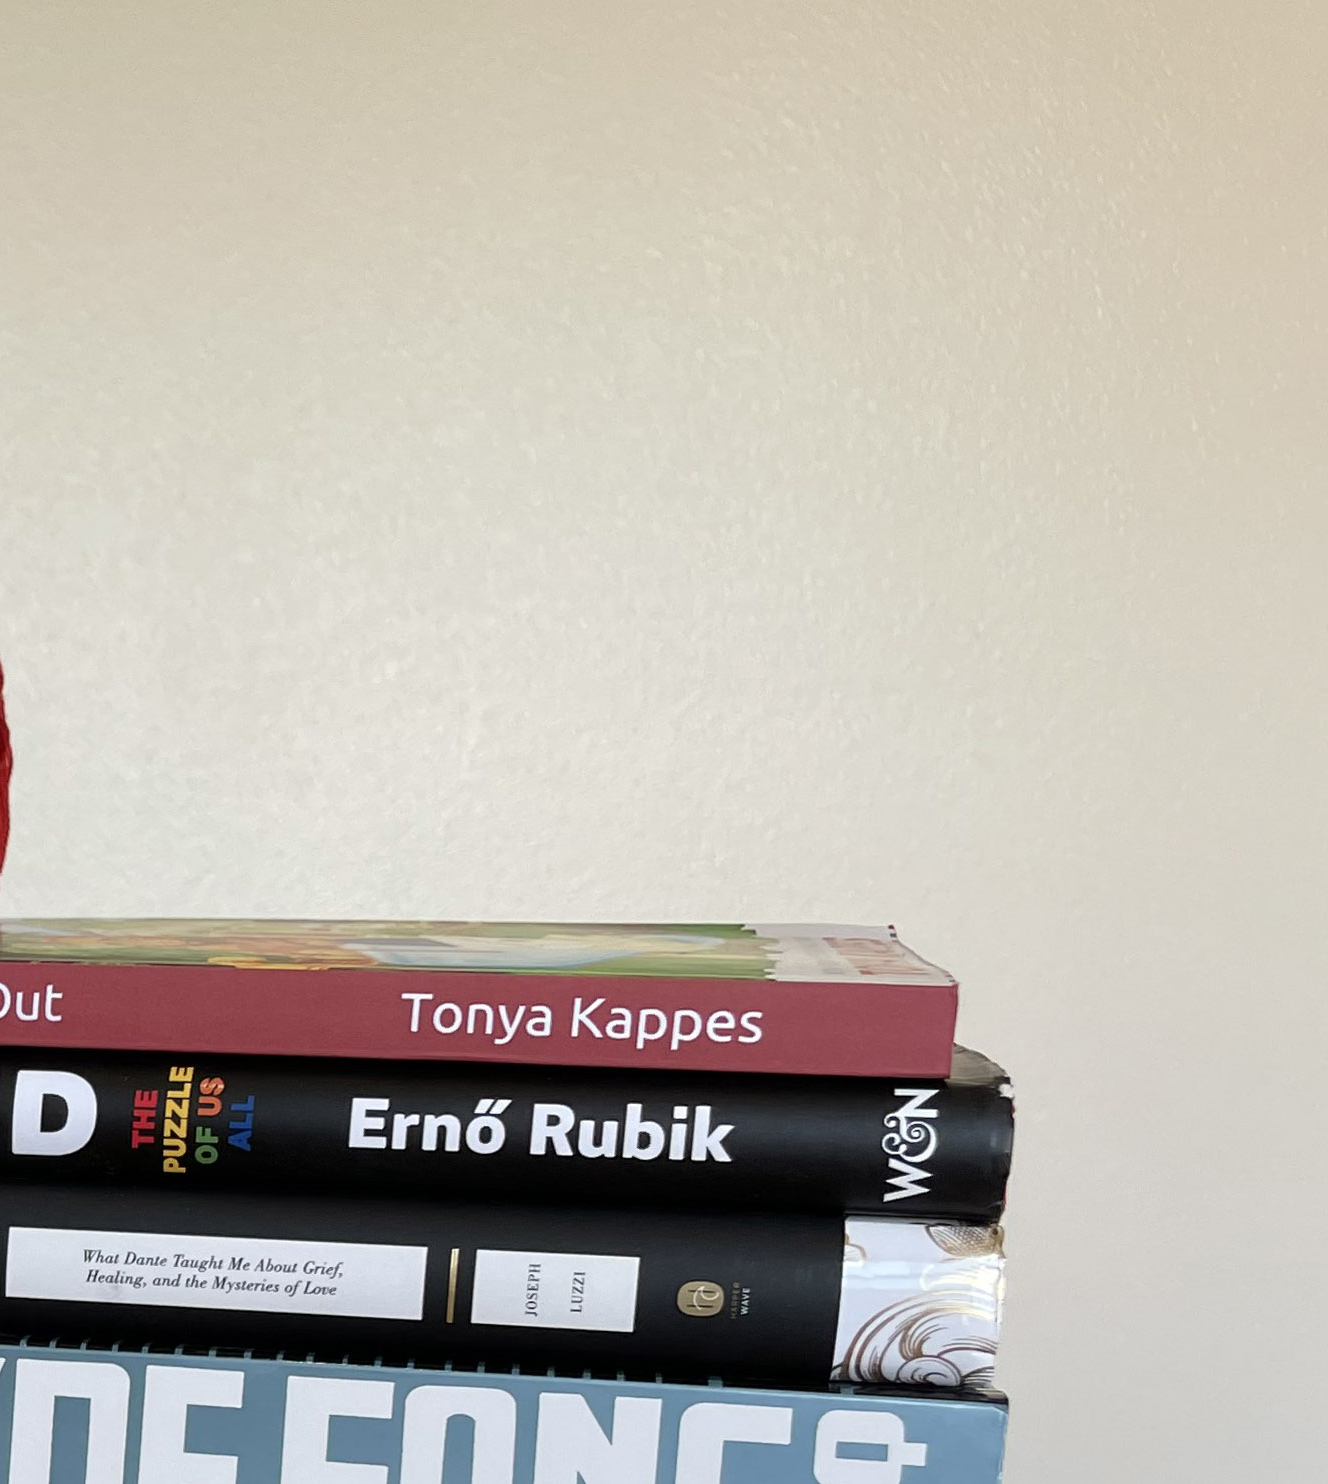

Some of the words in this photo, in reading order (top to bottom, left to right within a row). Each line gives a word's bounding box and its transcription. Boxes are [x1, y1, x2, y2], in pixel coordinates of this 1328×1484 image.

[401, 992, 553, 1045] Tonya
[570, 997, 764, 1050] Kappes
[130, 1088, 160, 1149] THE
[162, 1065, 195, 1175] PUZZLE
[200, 1076, 226, 1113] US
[195, 1116, 220, 1165] OF
[228, 1095, 256, 1151] ALL
[347, 1097, 514, 1154] Ernő
[528, 1101, 736, 1163] Rubik
[83, 1249, 120, 1265] What
[123, 1251, 168, 1268] Dante
[172, 1254, 224, 1273] Taught
[227, 1256, 252, 1271] Me
[254, 1257, 298, 1273] About
[302, 1261, 344, 1279] Grief,
[85, 1269, 148, 1288] Healing,
[152, 1273, 181, 1288] and
[185, 1274, 208, 1289] the
[211, 1276, 280, 1296] Mysteries
[284, 1279, 303, 1297] of
[302, 1281, 337, 1297] Love
[524, 1263, 542, 1317] JOSEPH
[570, 1271, 586, 1313] LUZZI
[740, 1287, 751, 1315] WAVE
